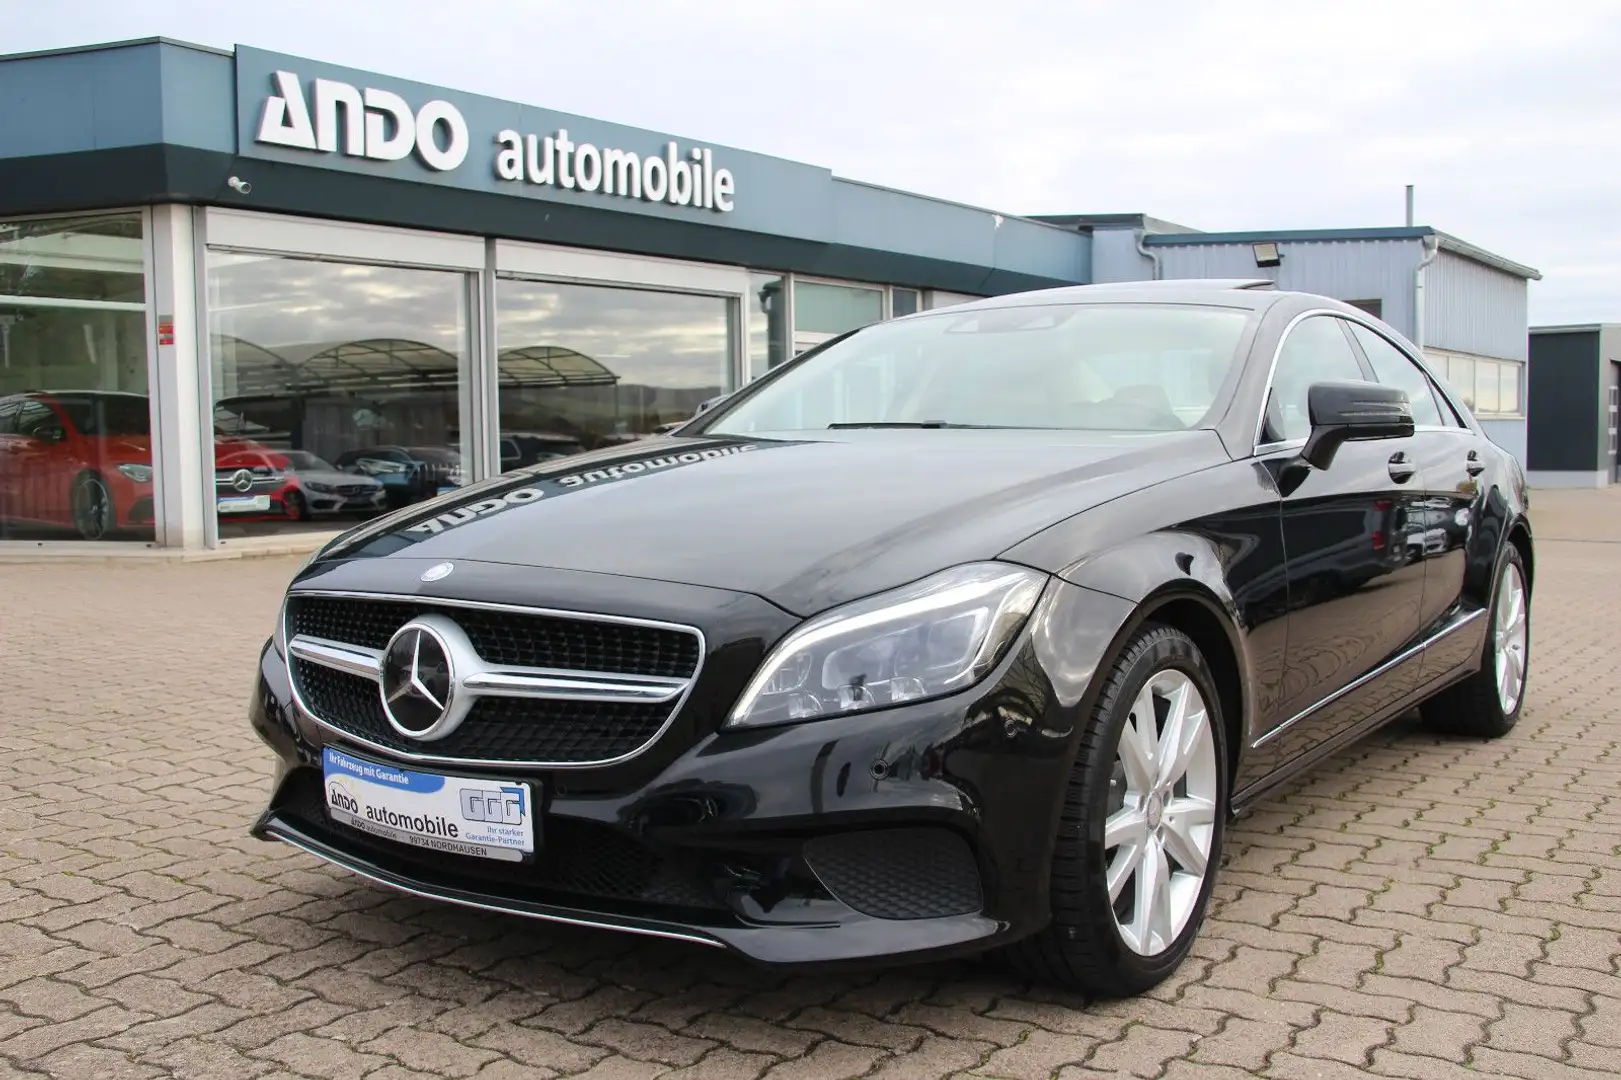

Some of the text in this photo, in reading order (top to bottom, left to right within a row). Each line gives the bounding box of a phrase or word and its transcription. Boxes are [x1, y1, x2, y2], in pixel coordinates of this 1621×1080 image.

[255, 70, 735, 213] ANDO automobile
[329, 752, 409, 785] Ihr Fahrzeug mit Garantie
[331, 789, 459, 838] ANDO automobile
[465, 832, 525, 846] Garantie-Partner
[487, 826, 524, 837] Ihr starker
[430, 839, 488, 856] NORDHAUSEN
